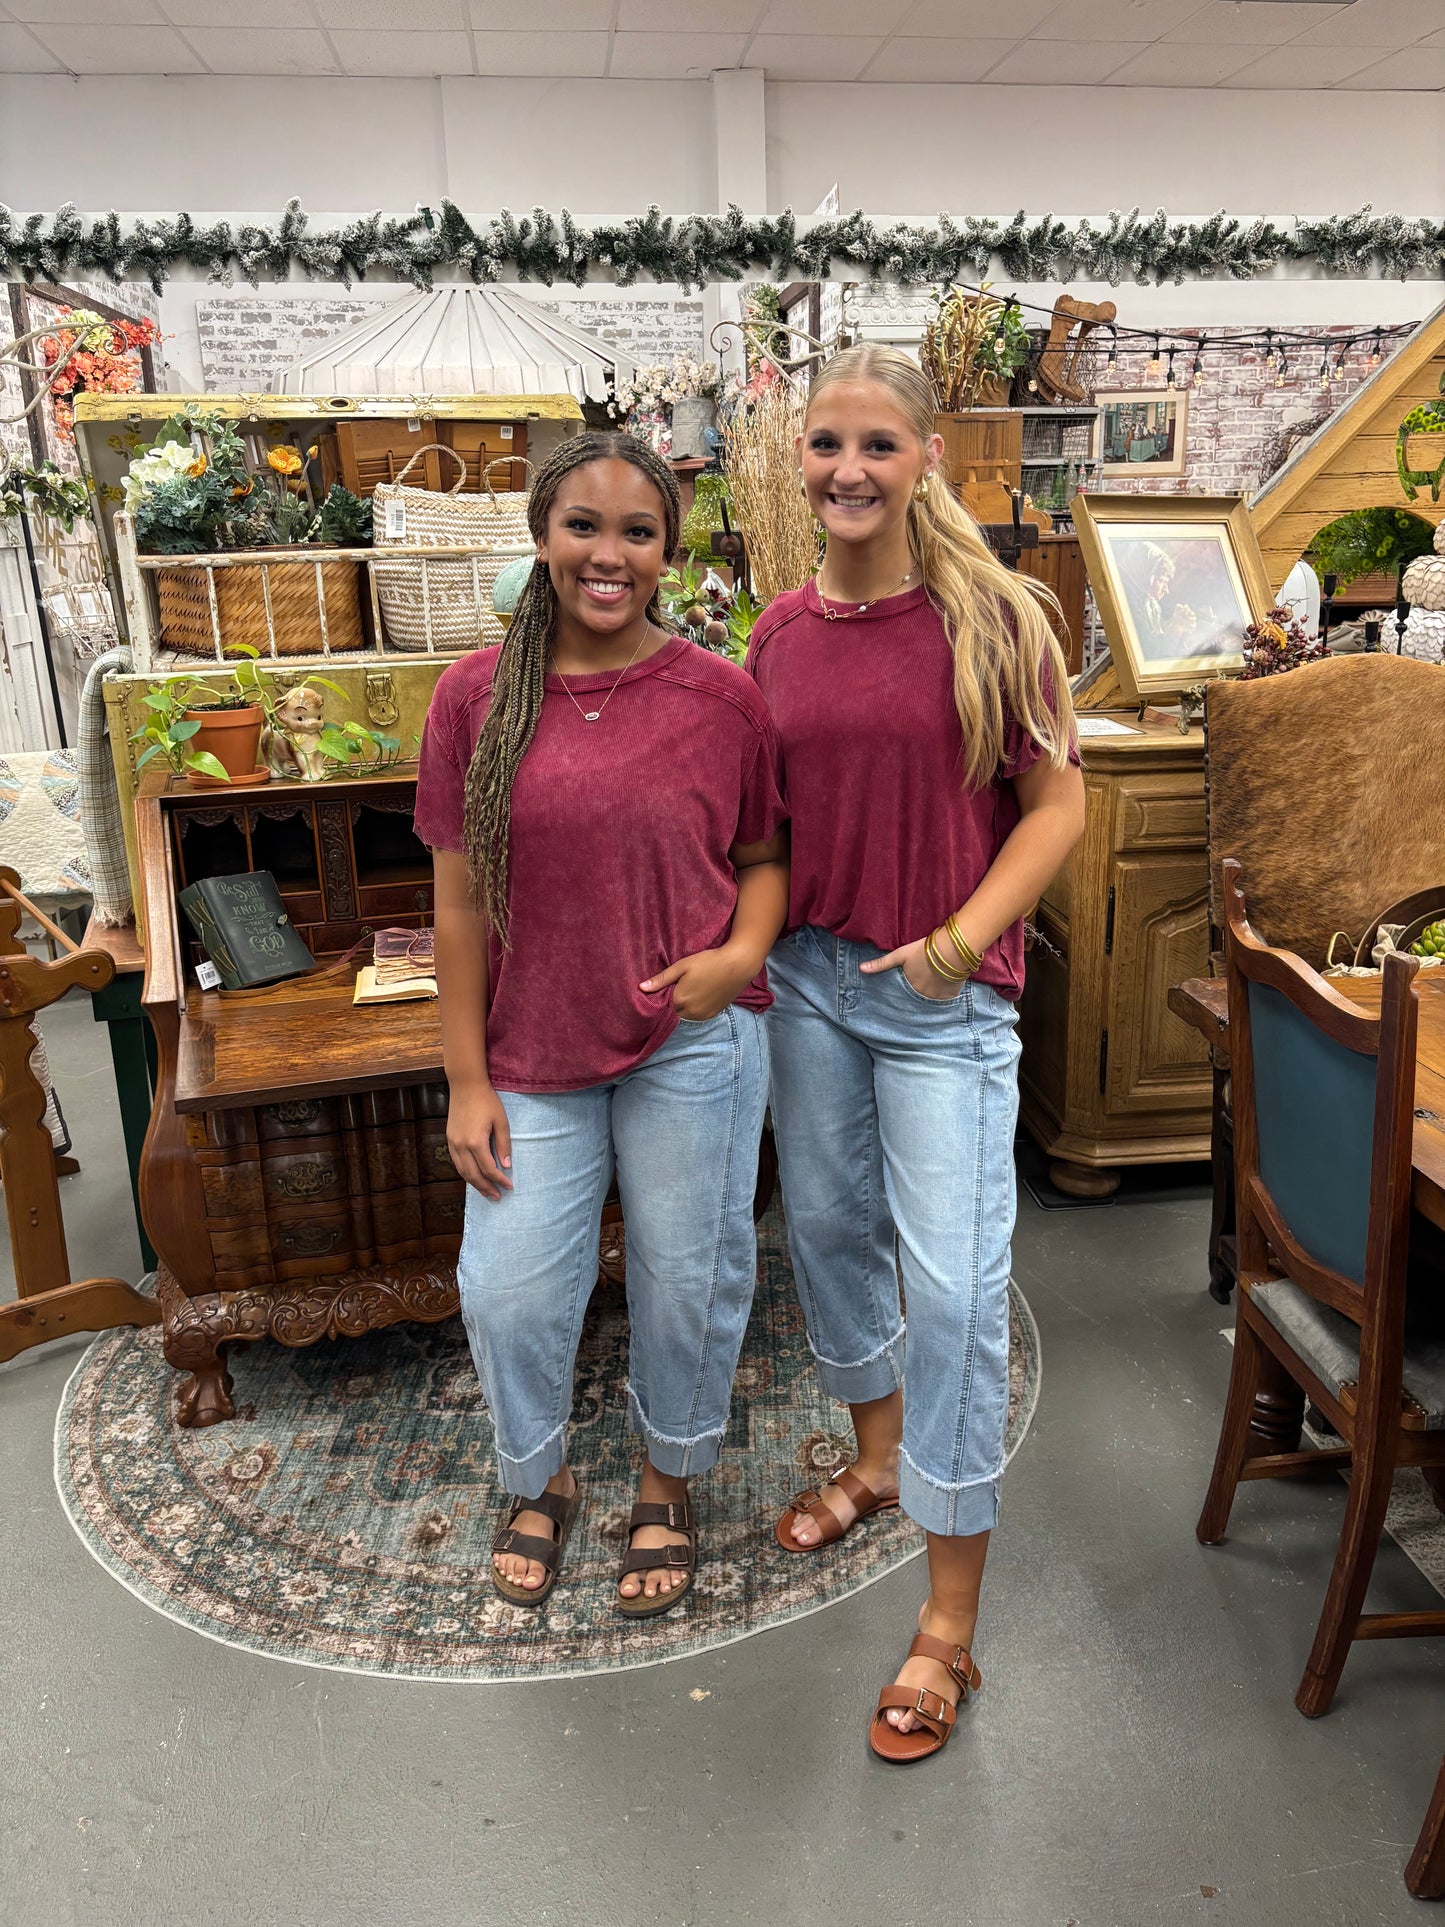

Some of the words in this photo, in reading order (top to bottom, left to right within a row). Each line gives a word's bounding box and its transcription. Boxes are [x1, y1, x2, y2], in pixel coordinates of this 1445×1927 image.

[33, 496, 68, 577] SHE
[232, 881, 261, 902] Still
[232, 903, 266, 916] KNOW
[249, 919, 264, 927] THAT
[249, 932, 284, 956] GOD
